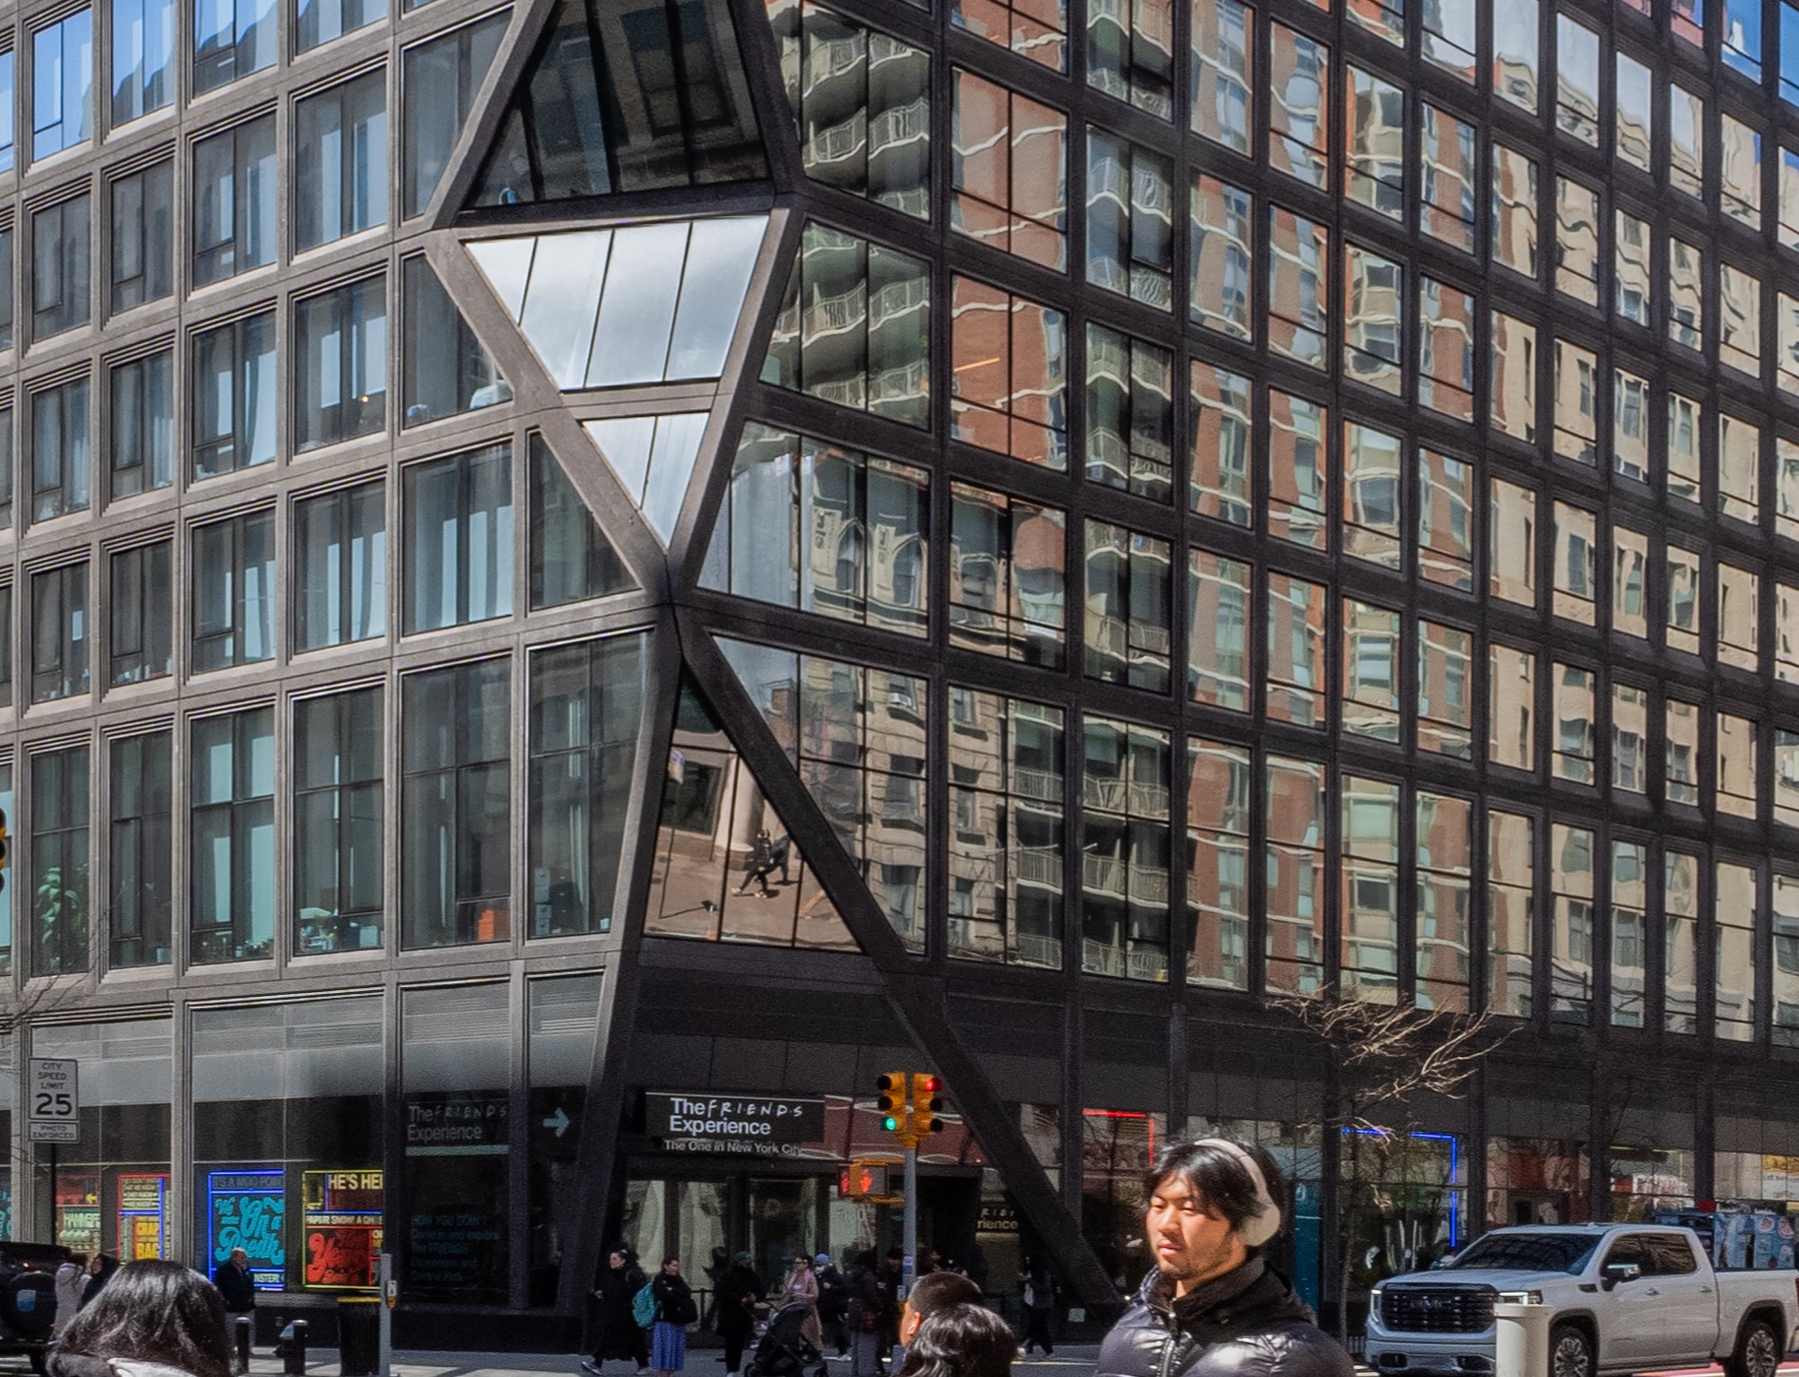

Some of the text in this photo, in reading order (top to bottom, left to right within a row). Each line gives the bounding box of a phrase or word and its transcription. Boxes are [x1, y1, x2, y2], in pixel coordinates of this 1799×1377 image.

[42, 1062, 63, 1070] CITY
[37, 1072, 67, 1080] SPEED
[41, 1082, 66, 1090] LIMIT
[35, 1093, 73, 1116] 25
[670, 1097, 705, 1115] The
[408, 1105, 434, 1122] The
[407, 1124, 483, 1144] Experience
[669, 1115, 772, 1137] Experience
[665, 1139, 802, 1157] The One in New York City
[328, 1174, 359, 1190] HE'S
